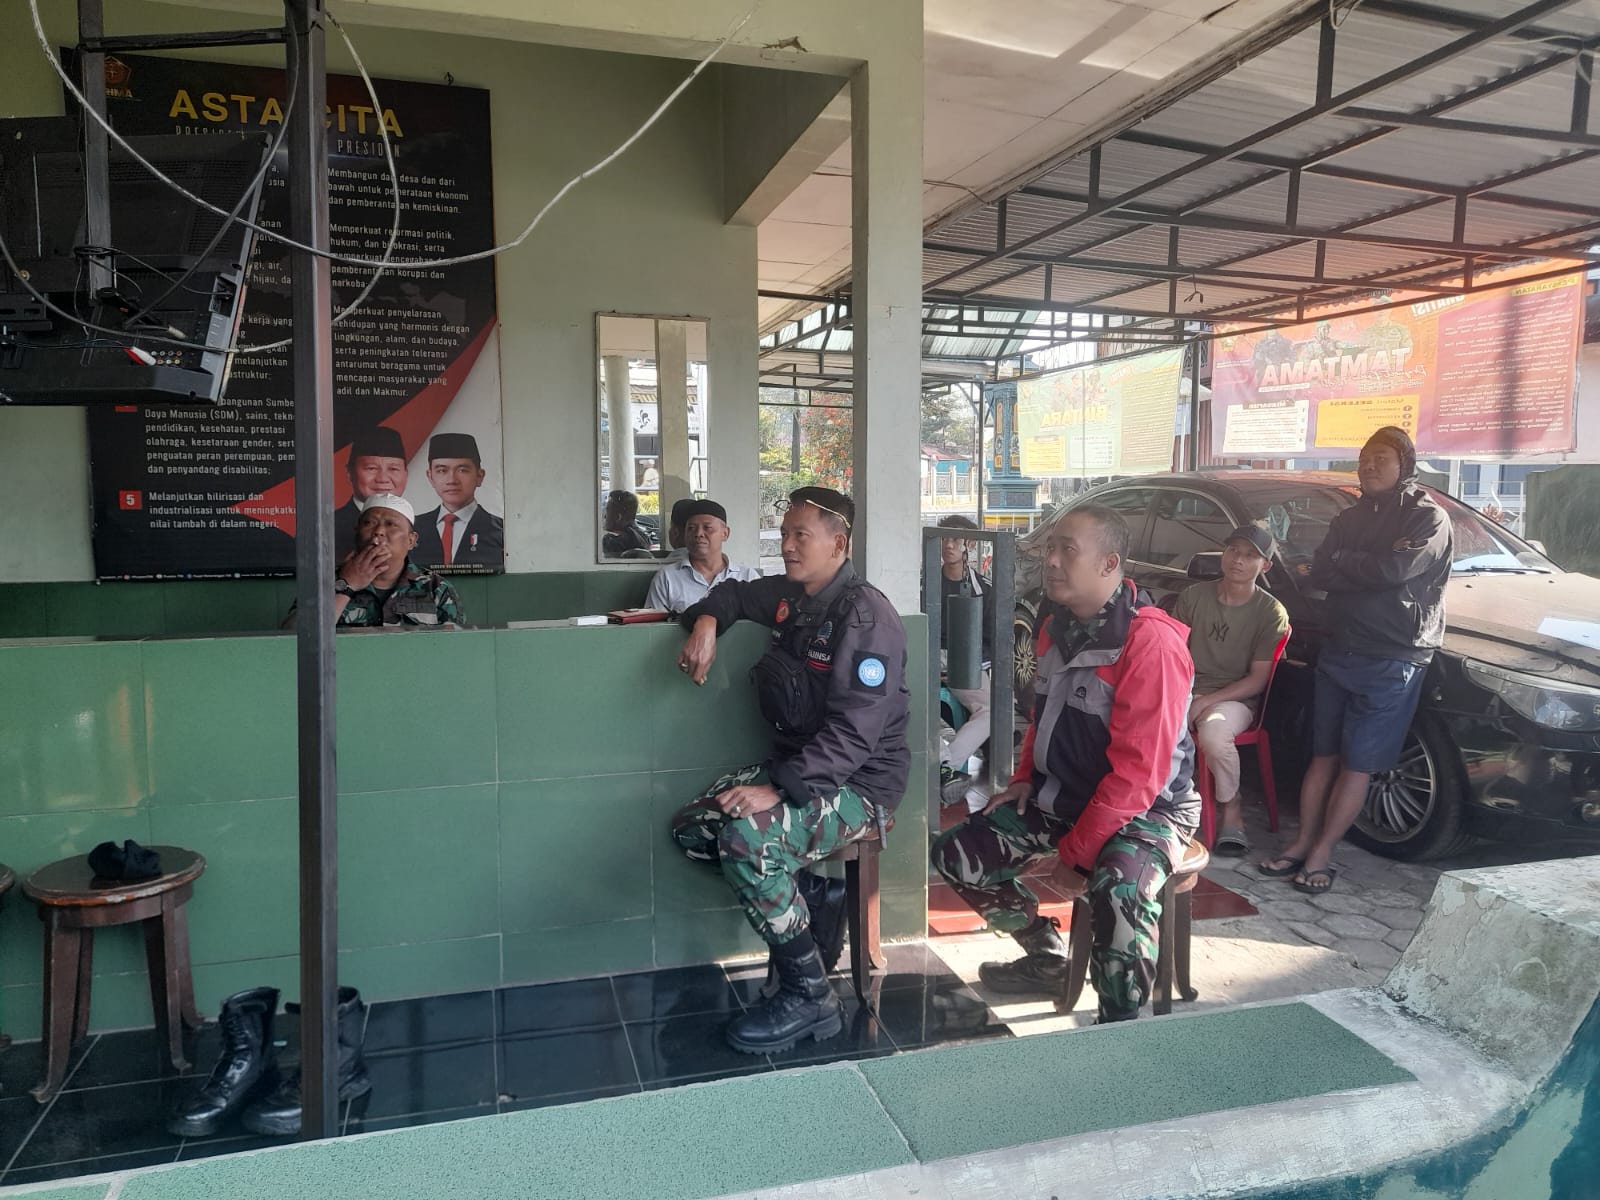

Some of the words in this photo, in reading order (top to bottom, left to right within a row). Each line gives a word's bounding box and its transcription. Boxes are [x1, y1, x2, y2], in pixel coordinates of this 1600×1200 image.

[168, 89, 284, 126] ASTA
[326, 103, 404, 138] ITA
[338, 139, 400, 158] PRESIDN
[327, 168, 378, 184] Membangun
[381, 171, 396, 182] da
[400, 174, 419, 184] desa
[421, 176, 436, 185] dan
[439, 176, 456, 186] dari
[327, 182, 355, 192] bawah
[358, 184, 382, 194] untuk
[436, 190, 470, 201] ekonomi
[328, 196, 344, 205] dan
[346, 198, 410, 210] pemberantaan
[330, 223, 382, 236] Memperkuat
[330, 237, 361, 248] hukum,
[364, 238, 380, 248] dan
[382, 239, 422, 252] biokrasi,
[424, 244, 446, 254] serta
[281, 274, 292, 284] da
[398, 267, 428, 280] korupsi
[430, 268, 446, 280] dan
[334, 305, 385, 318] Meperkuat
[388, 308, 442, 320] penyelarasan
[248, 315, 270, 326] kerja
[273, 317, 293, 327] yang
[379, 322, 399, 333] yang
[401, 322, 439, 332] harmonis
[442, 324, 471, 335] dengan
[334, 332, 383, 345] lingkungan,
[386, 334, 409, 345] alam,
[412, 335, 426, 345] dan
[336, 346, 358, 356] serta
[360, 347, 410, 358] peningkatan
[412, 348, 448, 360] toleransi
[234, 356, 288, 367] melanjutkan
[336, 360, 378, 370] antarumat
[380, 360, 421, 372] beragama
[424, 362, 447, 372] untuk
[336, 373, 376, 385] mencapai
[378, 374, 426, 386] masyarakat
[428, 376, 448, 386] yang
[336, 386, 352, 396] adil
[355, 386, 370, 396] dan
[373, 387, 410, 398] Makmur.
[266, 397, 294, 407] Sumbe
[145, 409, 167, 420] Daya
[170, 409, 207, 419] Manusia
[210, 408, 242, 421] (SDM),
[245, 410, 271, 421] sains,
[274, 410, 295, 421] tekn
[145, 423, 197, 434] pendidikan,
[200, 424, 248, 434] kesehatan,
[250, 424, 286, 435] prestasi
[146, 437, 188, 448] olahraga,
[191, 438, 239, 447] kesetaraan
[242, 438, 274, 449] gender,
[278, 439, 295, 448] sert
[147, 452, 193, 462] penguatan
[196, 452, 221, 462] peran
[224, 453, 275, 463] perempuan,
[278, 454, 296, 463] pem
[148, 465, 164, 474] dan
[167, 465, 220, 476] penyandang
[222, 465, 271, 476] disabilitas;
[126, 494, 136, 506] 5
[149, 492, 204, 503] Melanjutkan
[207, 492, 245, 501] hilirisasi
[248, 492, 264, 501] dan
[150, 506, 213, 515] industrialisasi
[216, 506, 241, 515] untuk
[150, 519, 171, 529] nilai
[173, 519, 206, 529] tambah
[209, 519, 218, 529] di
[220, 519, 247, 529] dalam
[250, 520, 279, 530] negeri;
